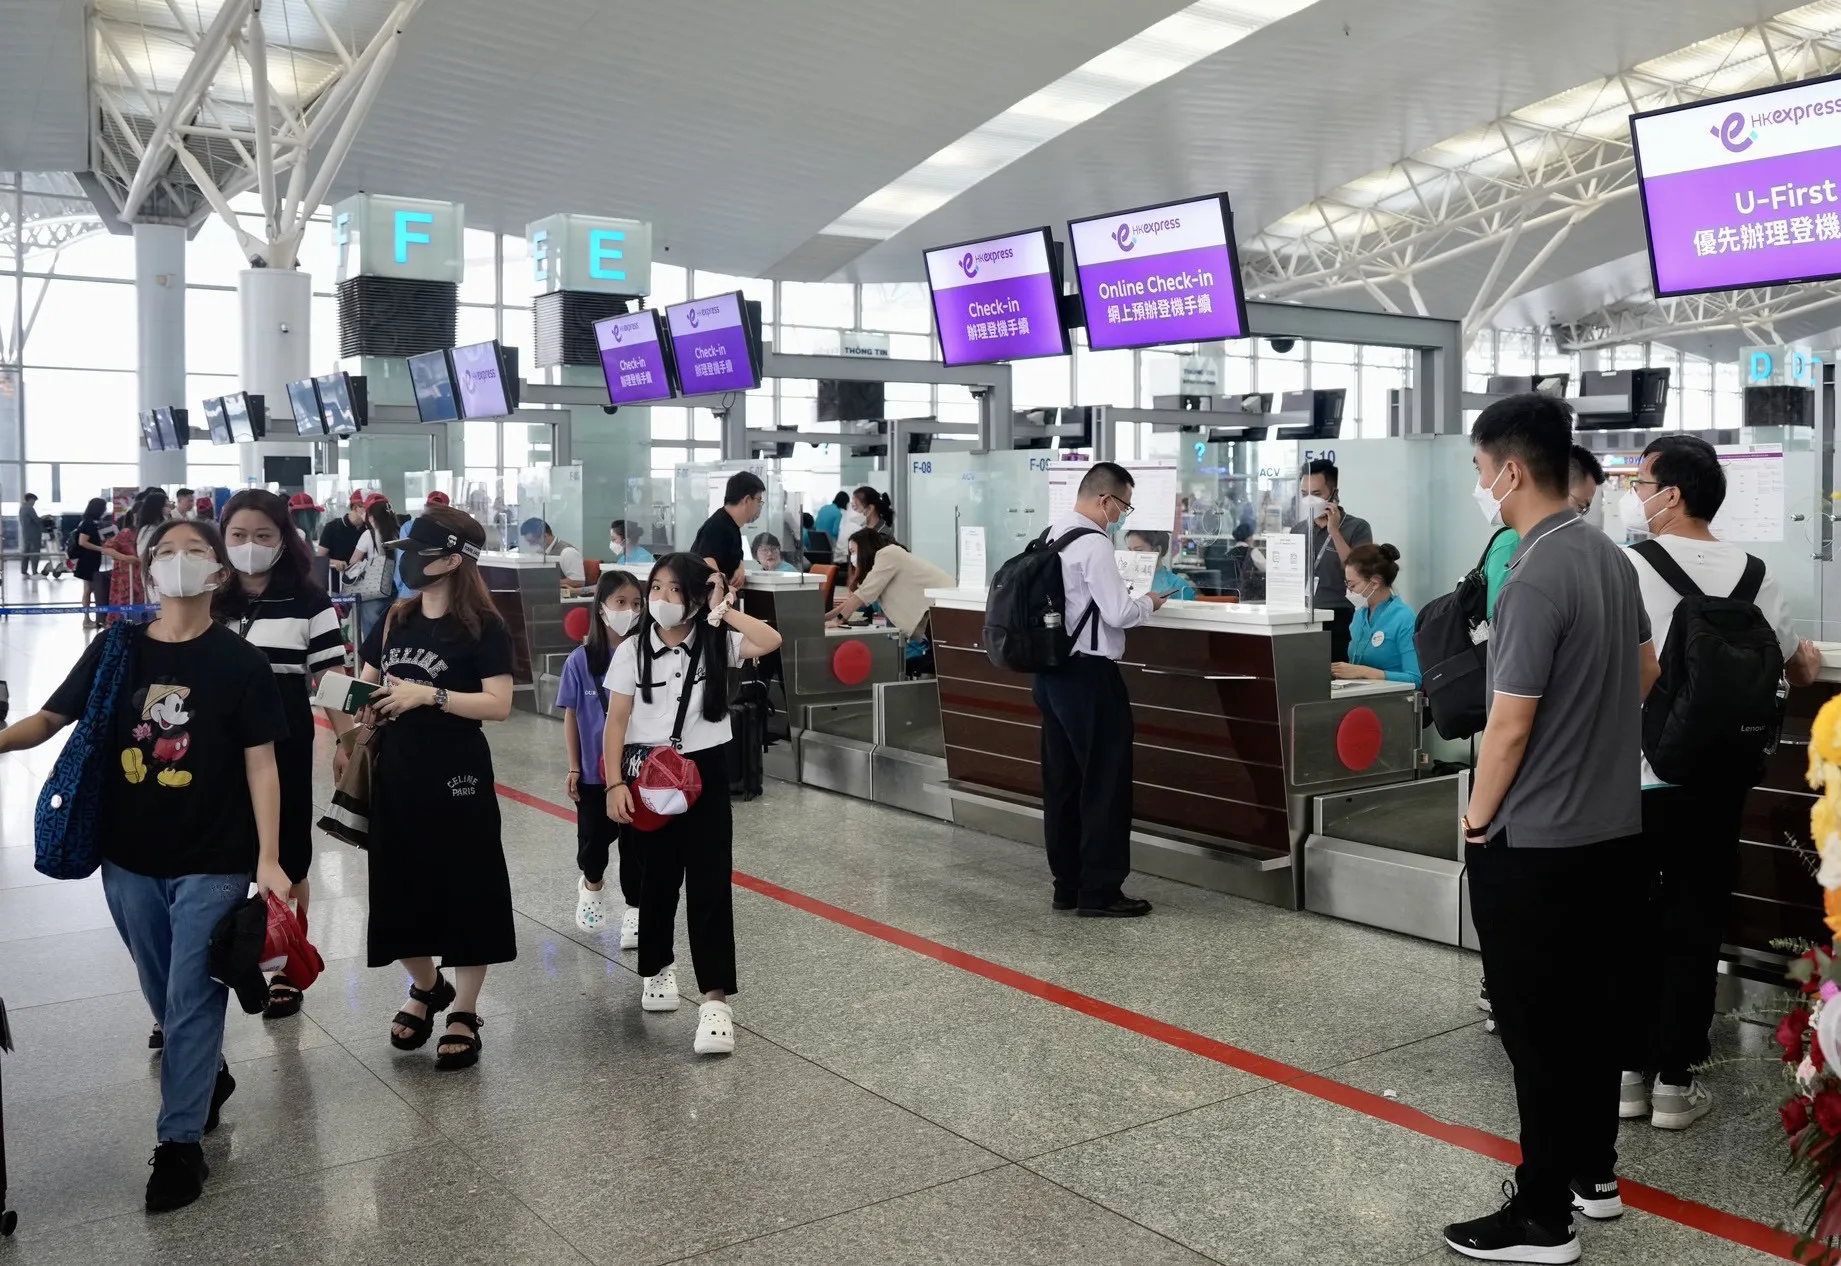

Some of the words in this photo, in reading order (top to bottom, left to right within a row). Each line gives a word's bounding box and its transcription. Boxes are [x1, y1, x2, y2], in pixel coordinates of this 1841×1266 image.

[1735, 179, 1838, 215] U-First
[394, 210, 433, 264] F
[1132, 218, 1181, 236] HKexpress
[590, 229, 626, 281] E
[974, 248, 1014, 264] HKexpress
[1098, 279, 1144, 300] Online
[1147, 268, 1214, 293] Check-in
[968, 296, 1020, 318] Check-in
[1107, 293, 1212, 323] 網上預辦登機手續
[966, 317, 1030, 341] 辦理登機手續
[694, 343, 727, 359] Check-in
[619, 356, 647, 371] Check-in
[1751, 352, 1772, 379] D
[914, 461, 932, 473] F-08
[1260, 467, 1280, 477] ACV
[381, 647, 448, 680] CELINE
[1741, 724, 1766, 732] Lenov
[447, 775, 479, 789] CELINE
[452, 787, 476, 797] PARIS
